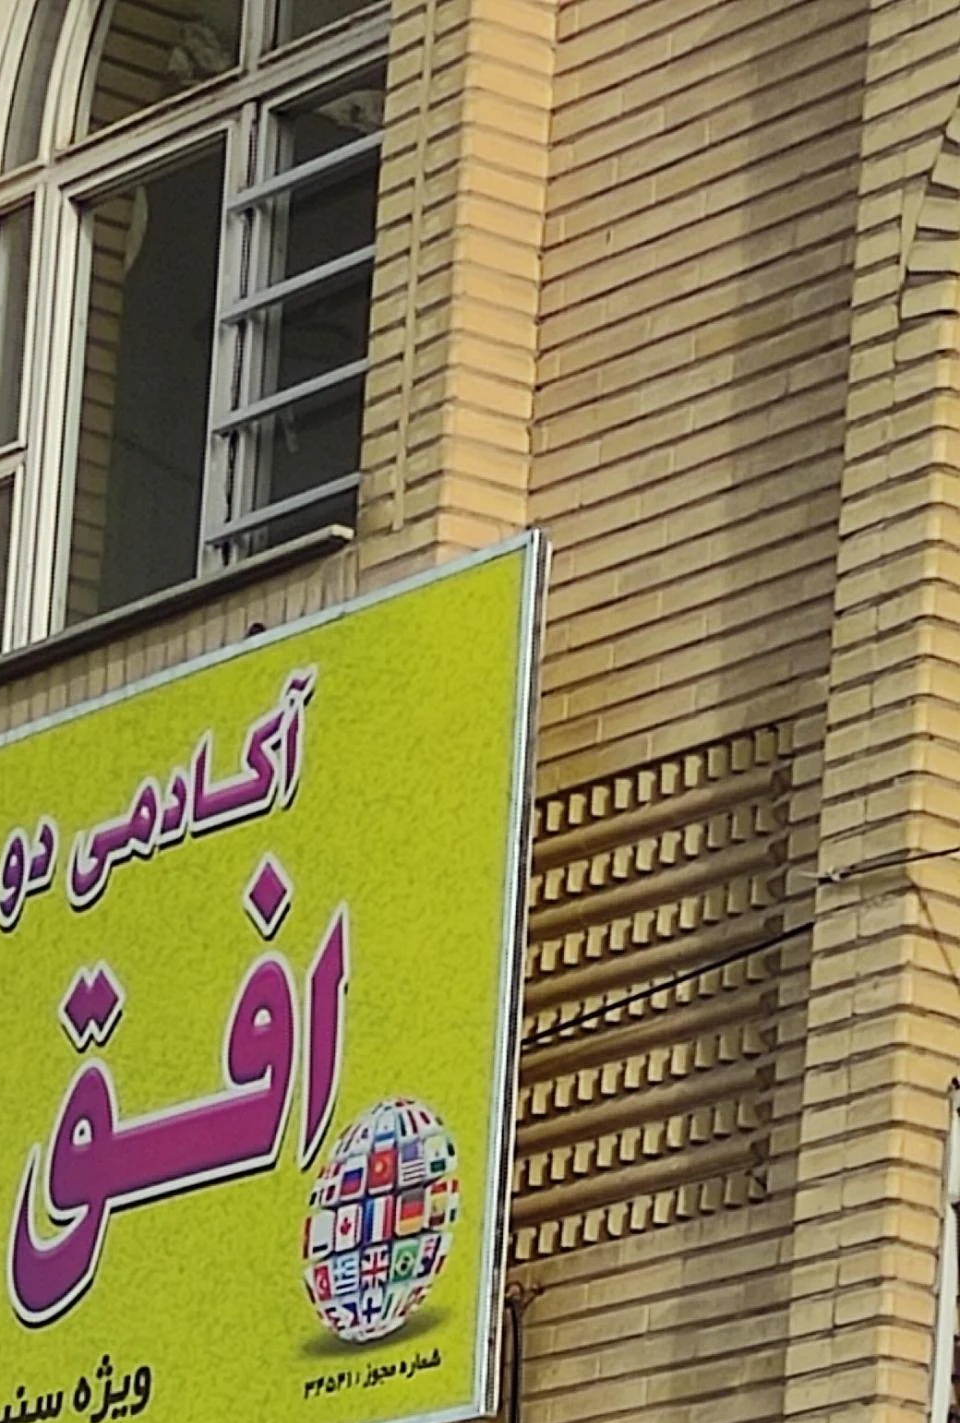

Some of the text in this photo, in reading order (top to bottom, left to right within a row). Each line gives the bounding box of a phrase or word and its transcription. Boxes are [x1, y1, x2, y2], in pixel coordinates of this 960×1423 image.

[69, 667, 318, 908] آکادمی
[10, 858, 351, 1325] افق
[74, 1356, 152, 1423] ویژه
[400, 1348, 441, 1378] شماره
